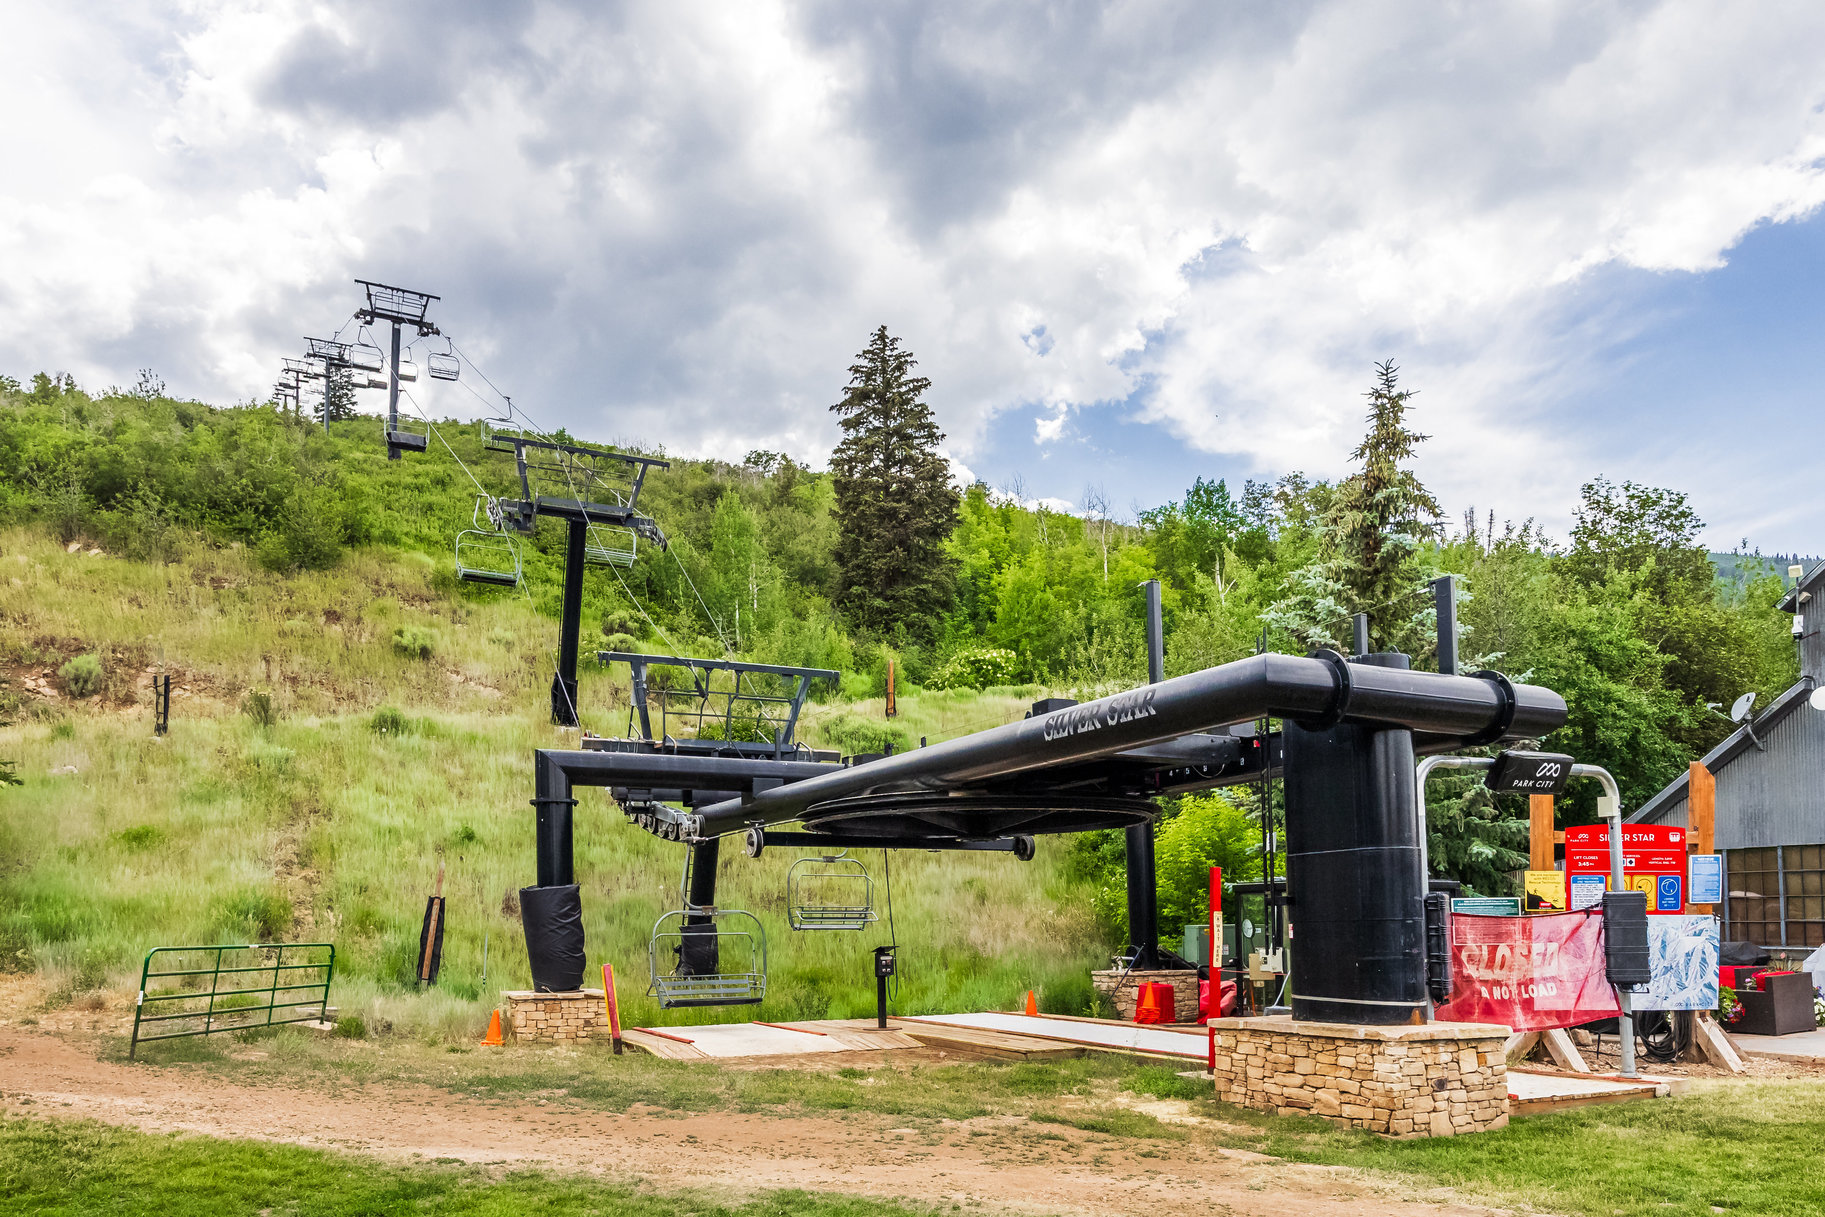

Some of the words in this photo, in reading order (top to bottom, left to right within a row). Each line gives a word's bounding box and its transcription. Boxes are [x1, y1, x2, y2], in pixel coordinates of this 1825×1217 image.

[1043, 704, 1101, 741] SILVER
[1107, 689, 1157, 726] STAR
[1512, 779, 1535, 788] PARK
[1536, 780, 1555, 788] CITY
[1599, 833, 1630, 842] SIER
[1632, 833, 1655, 842] STAR
[1461, 942, 1560, 981] CLOSED
[1493, 986, 1518, 1001] NOT
[1521, 982, 1558, 999] LOAD
